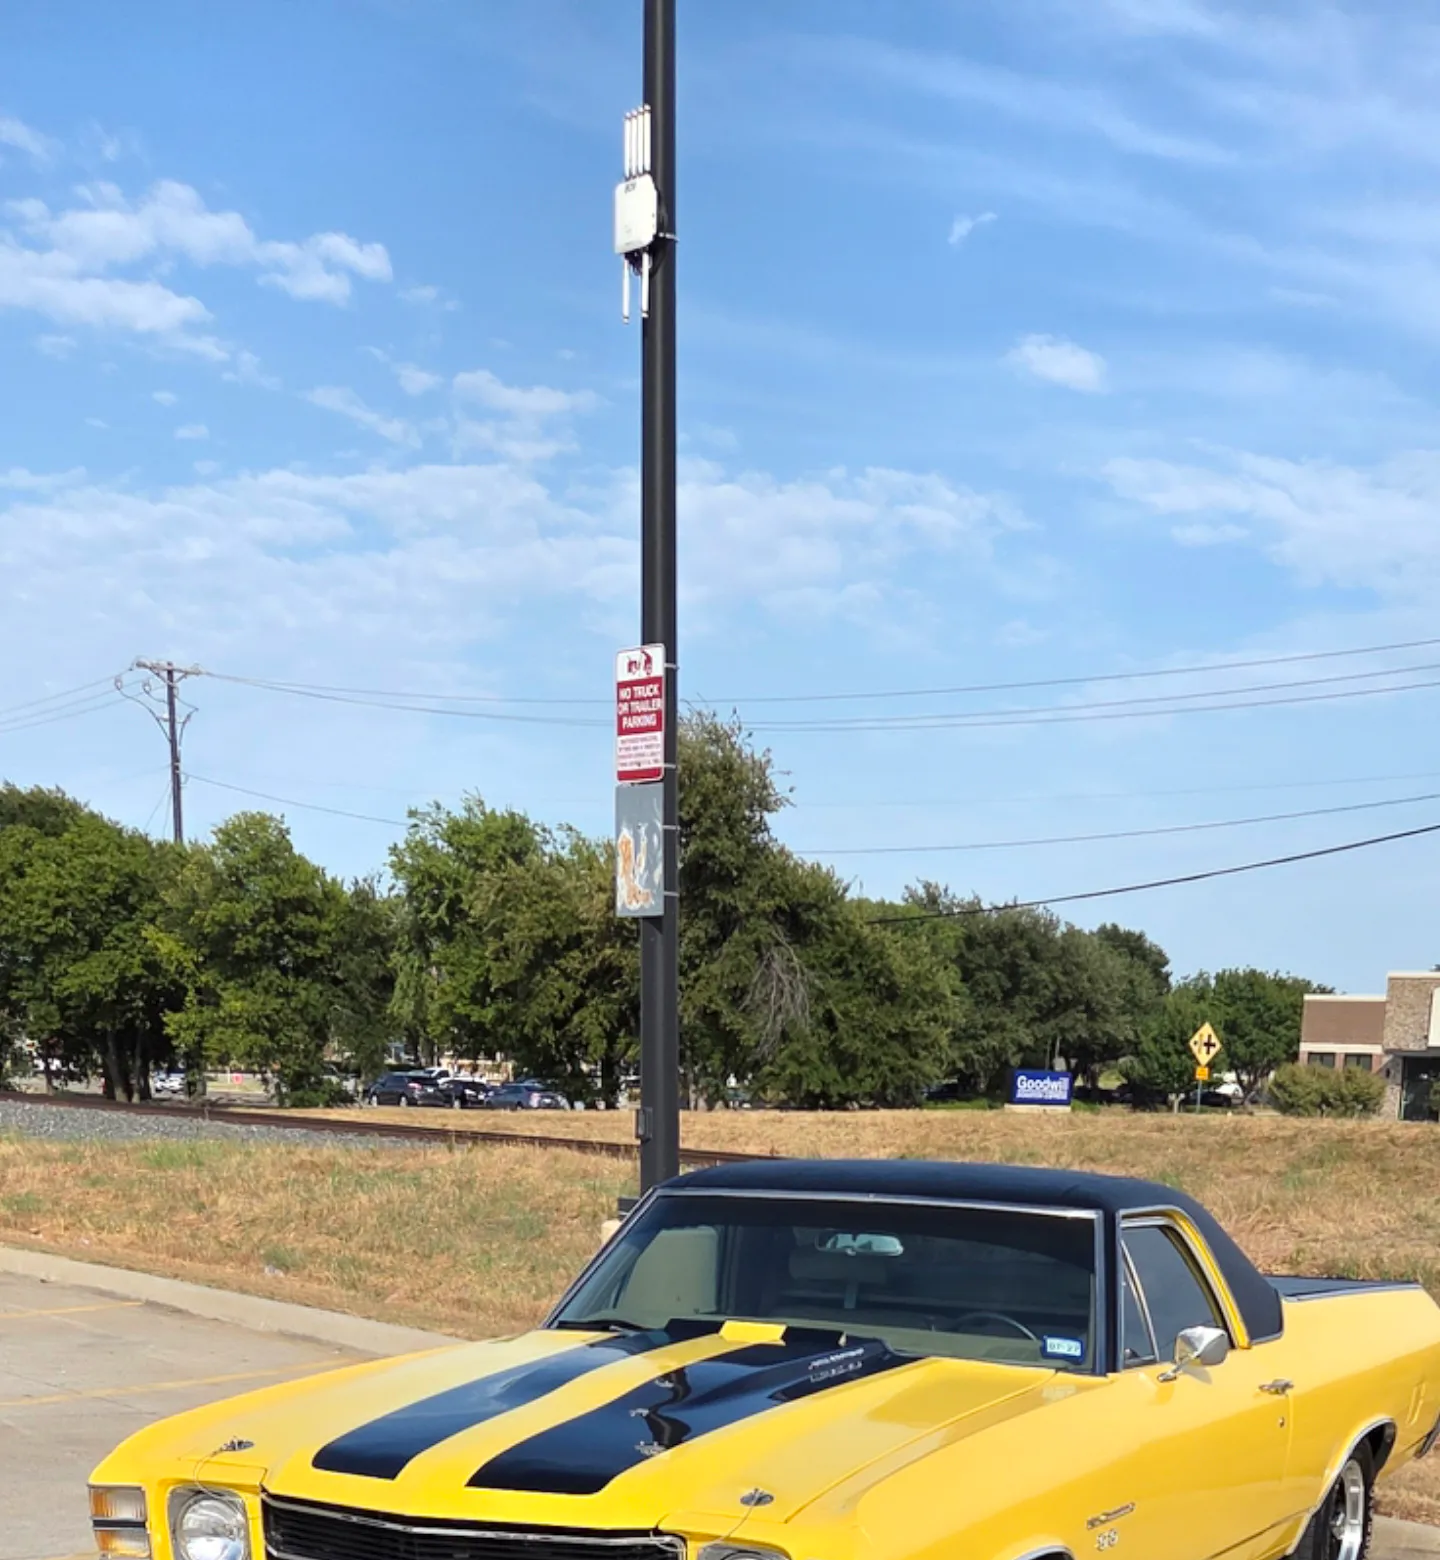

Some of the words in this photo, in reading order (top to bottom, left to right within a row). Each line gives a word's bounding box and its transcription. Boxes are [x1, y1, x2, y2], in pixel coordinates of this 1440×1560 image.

[619, 687, 631, 700] NO
[633, 683, 660, 699] TRUCK
[618, 701, 630, 715] OR
[630, 698, 661, 714] TRAILER
[622, 713, 657, 730] PARKING
